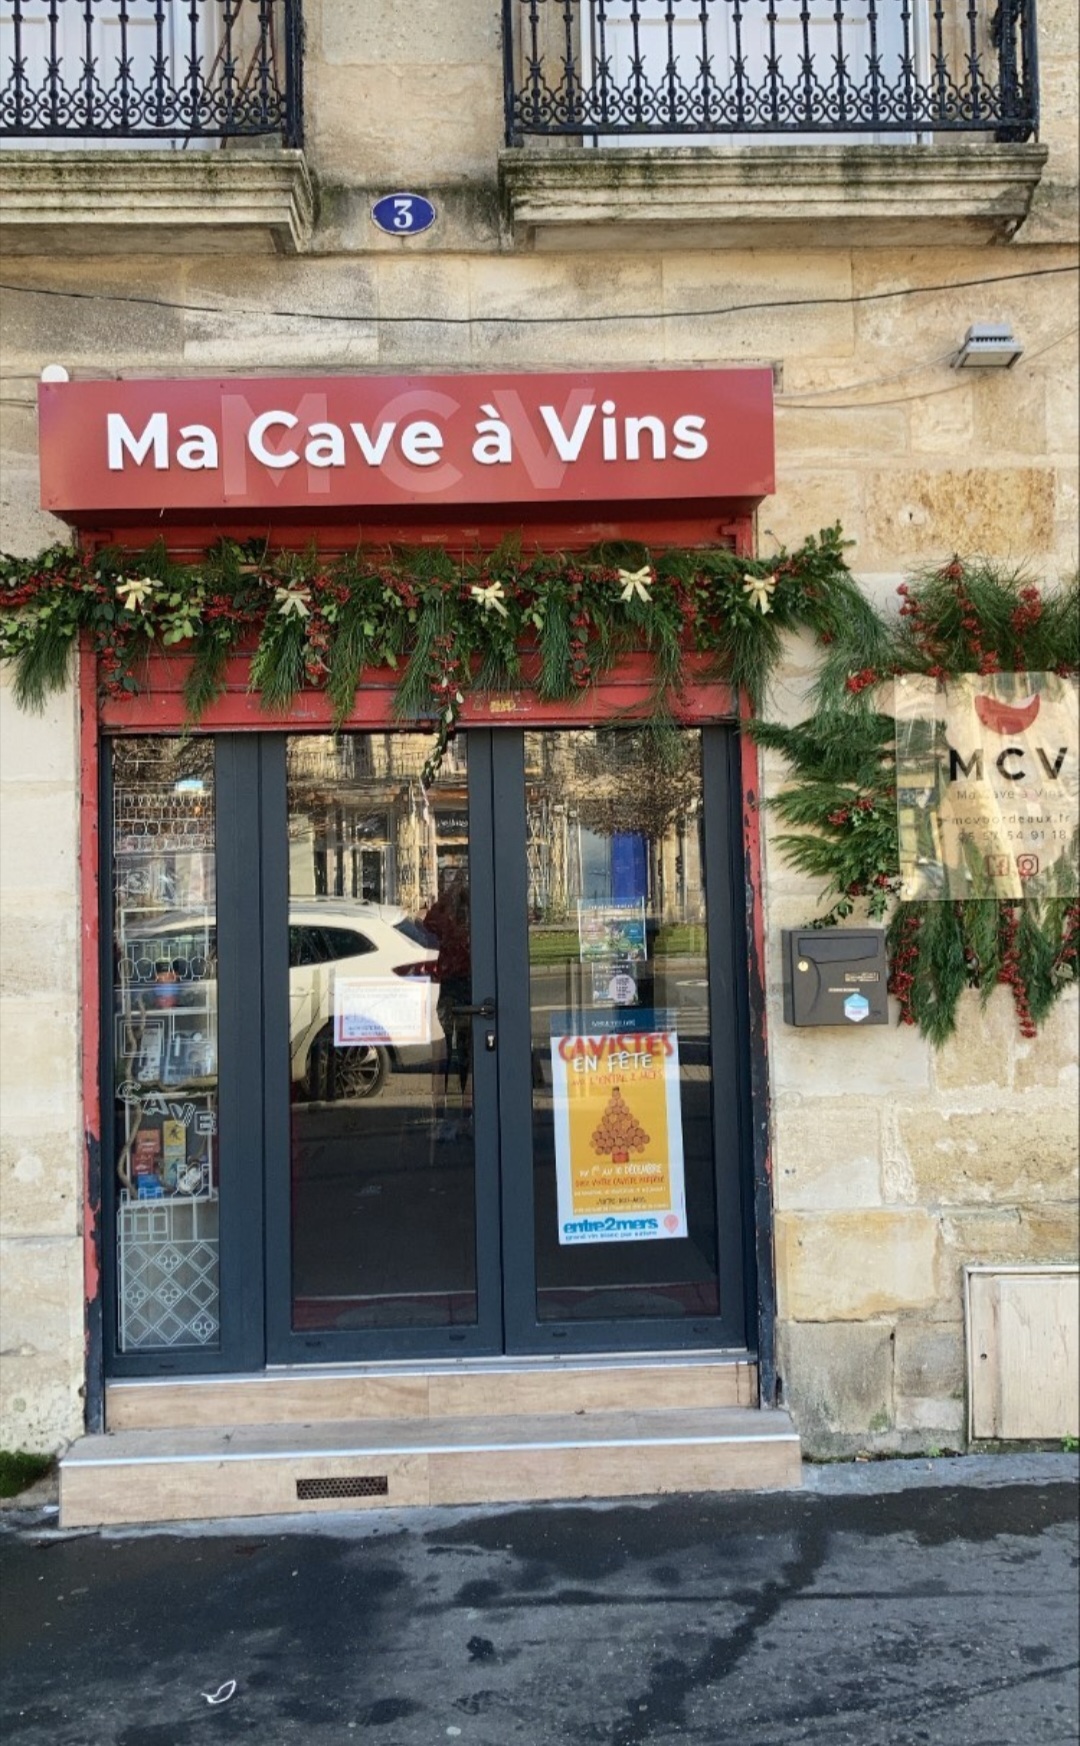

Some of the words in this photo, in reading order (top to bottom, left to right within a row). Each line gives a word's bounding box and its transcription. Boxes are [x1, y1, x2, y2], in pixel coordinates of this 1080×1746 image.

[394, 199, 413, 229] 3
[107, 412, 219, 471] Ma
[248, 409, 444, 468] Cave
[472, 404, 513, 464] à
[540, 400, 708, 462] Vins
[949, 747, 1069, 781] MCV
[979, 789, 1015, 800] ave
[1030, 830, 1046, 841] 91
[1051, 829, 1066, 841] 18
[558, 1032, 674, 1062] CAVISTES
[572, 1056, 597, 1073] EN
[607, 1050, 653, 1073] FÊTE
[563, 1216, 659, 1234] entre2mers
